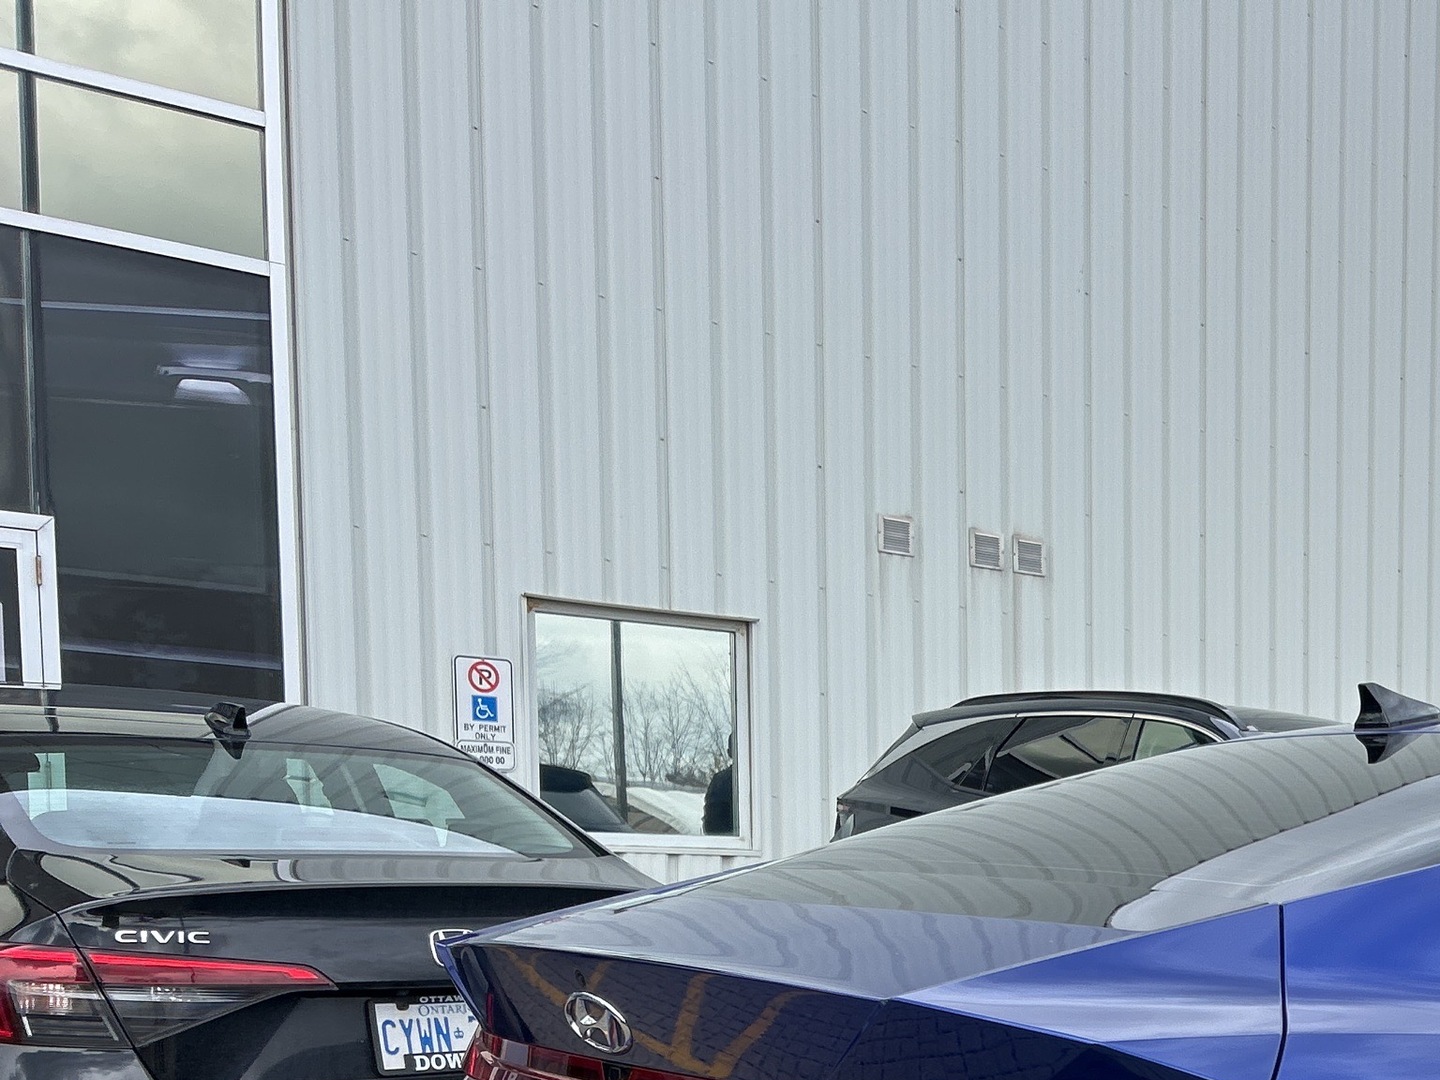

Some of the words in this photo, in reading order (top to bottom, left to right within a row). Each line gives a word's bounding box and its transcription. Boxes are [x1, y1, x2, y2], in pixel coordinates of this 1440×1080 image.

[463, 723, 475, 732] BY
[478, 724, 507, 733] PERMIT
[475, 732, 496, 741] ONLY
[495, 746, 511, 755] FINE
[114, 930, 211, 944] CIVIC
[419, 995, 465, 1003] OTTAW
[418, 1004, 471, 1016] ONTARI
[381, 1017, 453, 1056] CYWN
